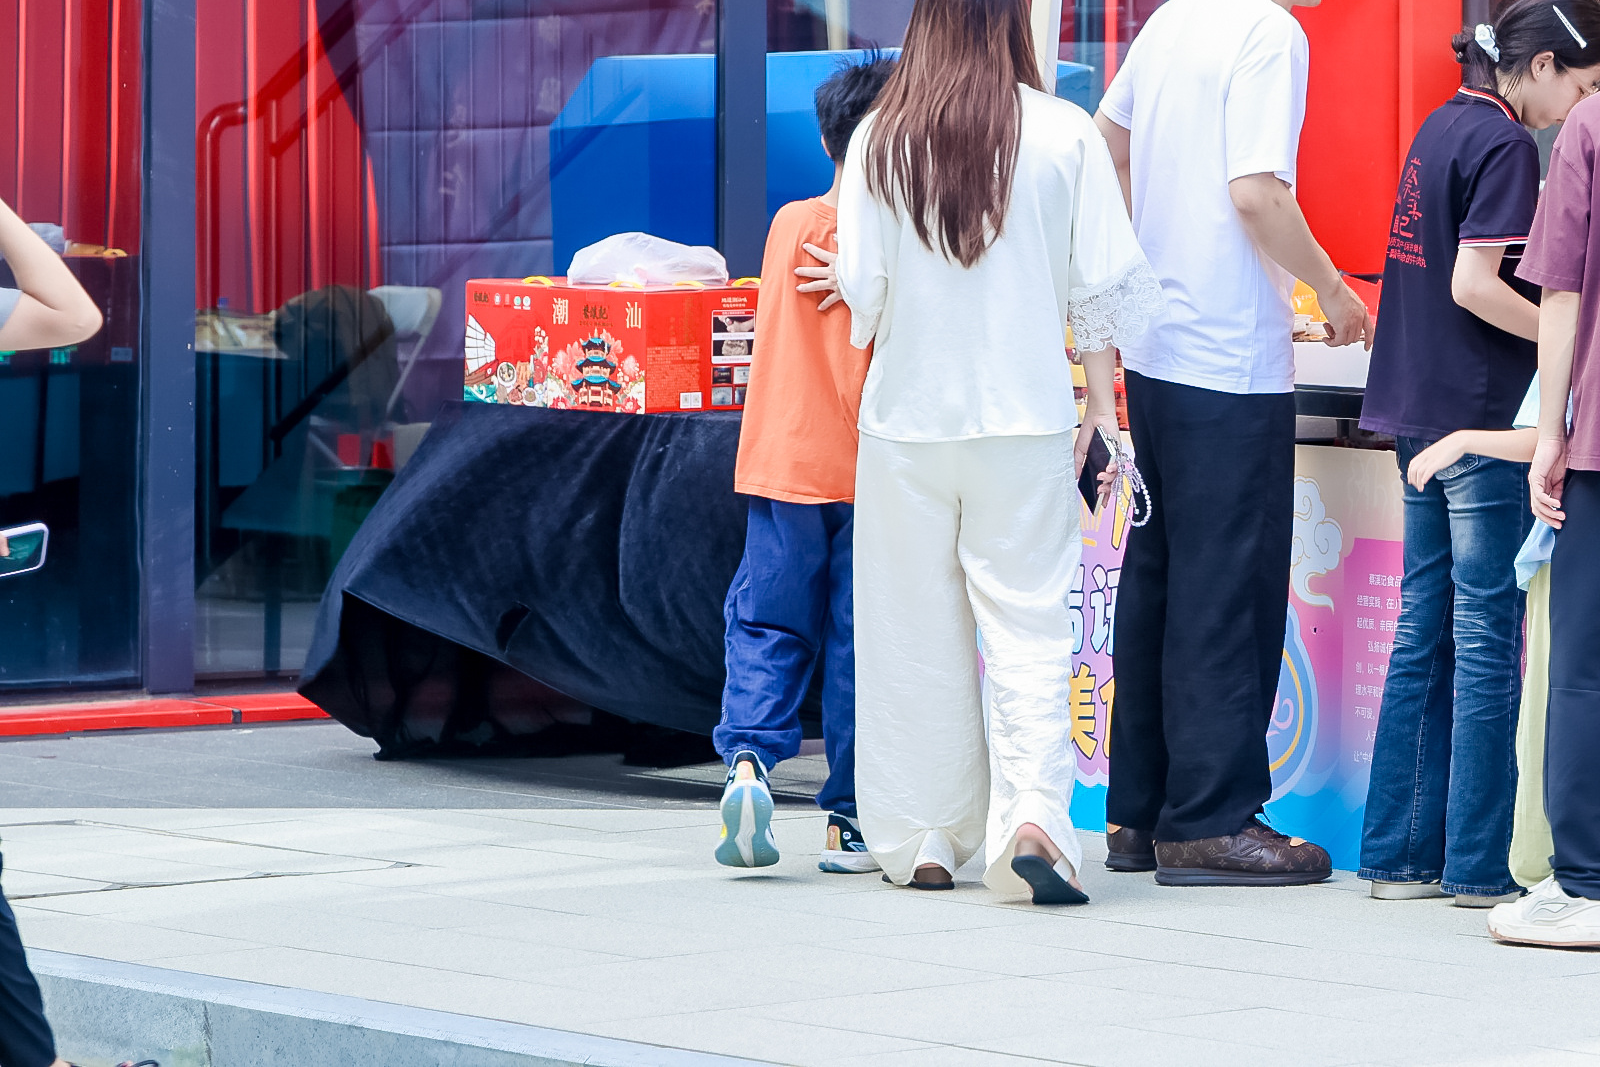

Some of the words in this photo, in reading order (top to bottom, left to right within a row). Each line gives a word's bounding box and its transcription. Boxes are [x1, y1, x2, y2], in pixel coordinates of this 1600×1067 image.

[552, 297, 569, 325] 潮
[625, 301, 642, 329] 汕
[1069, 661, 1115, 760] 美
